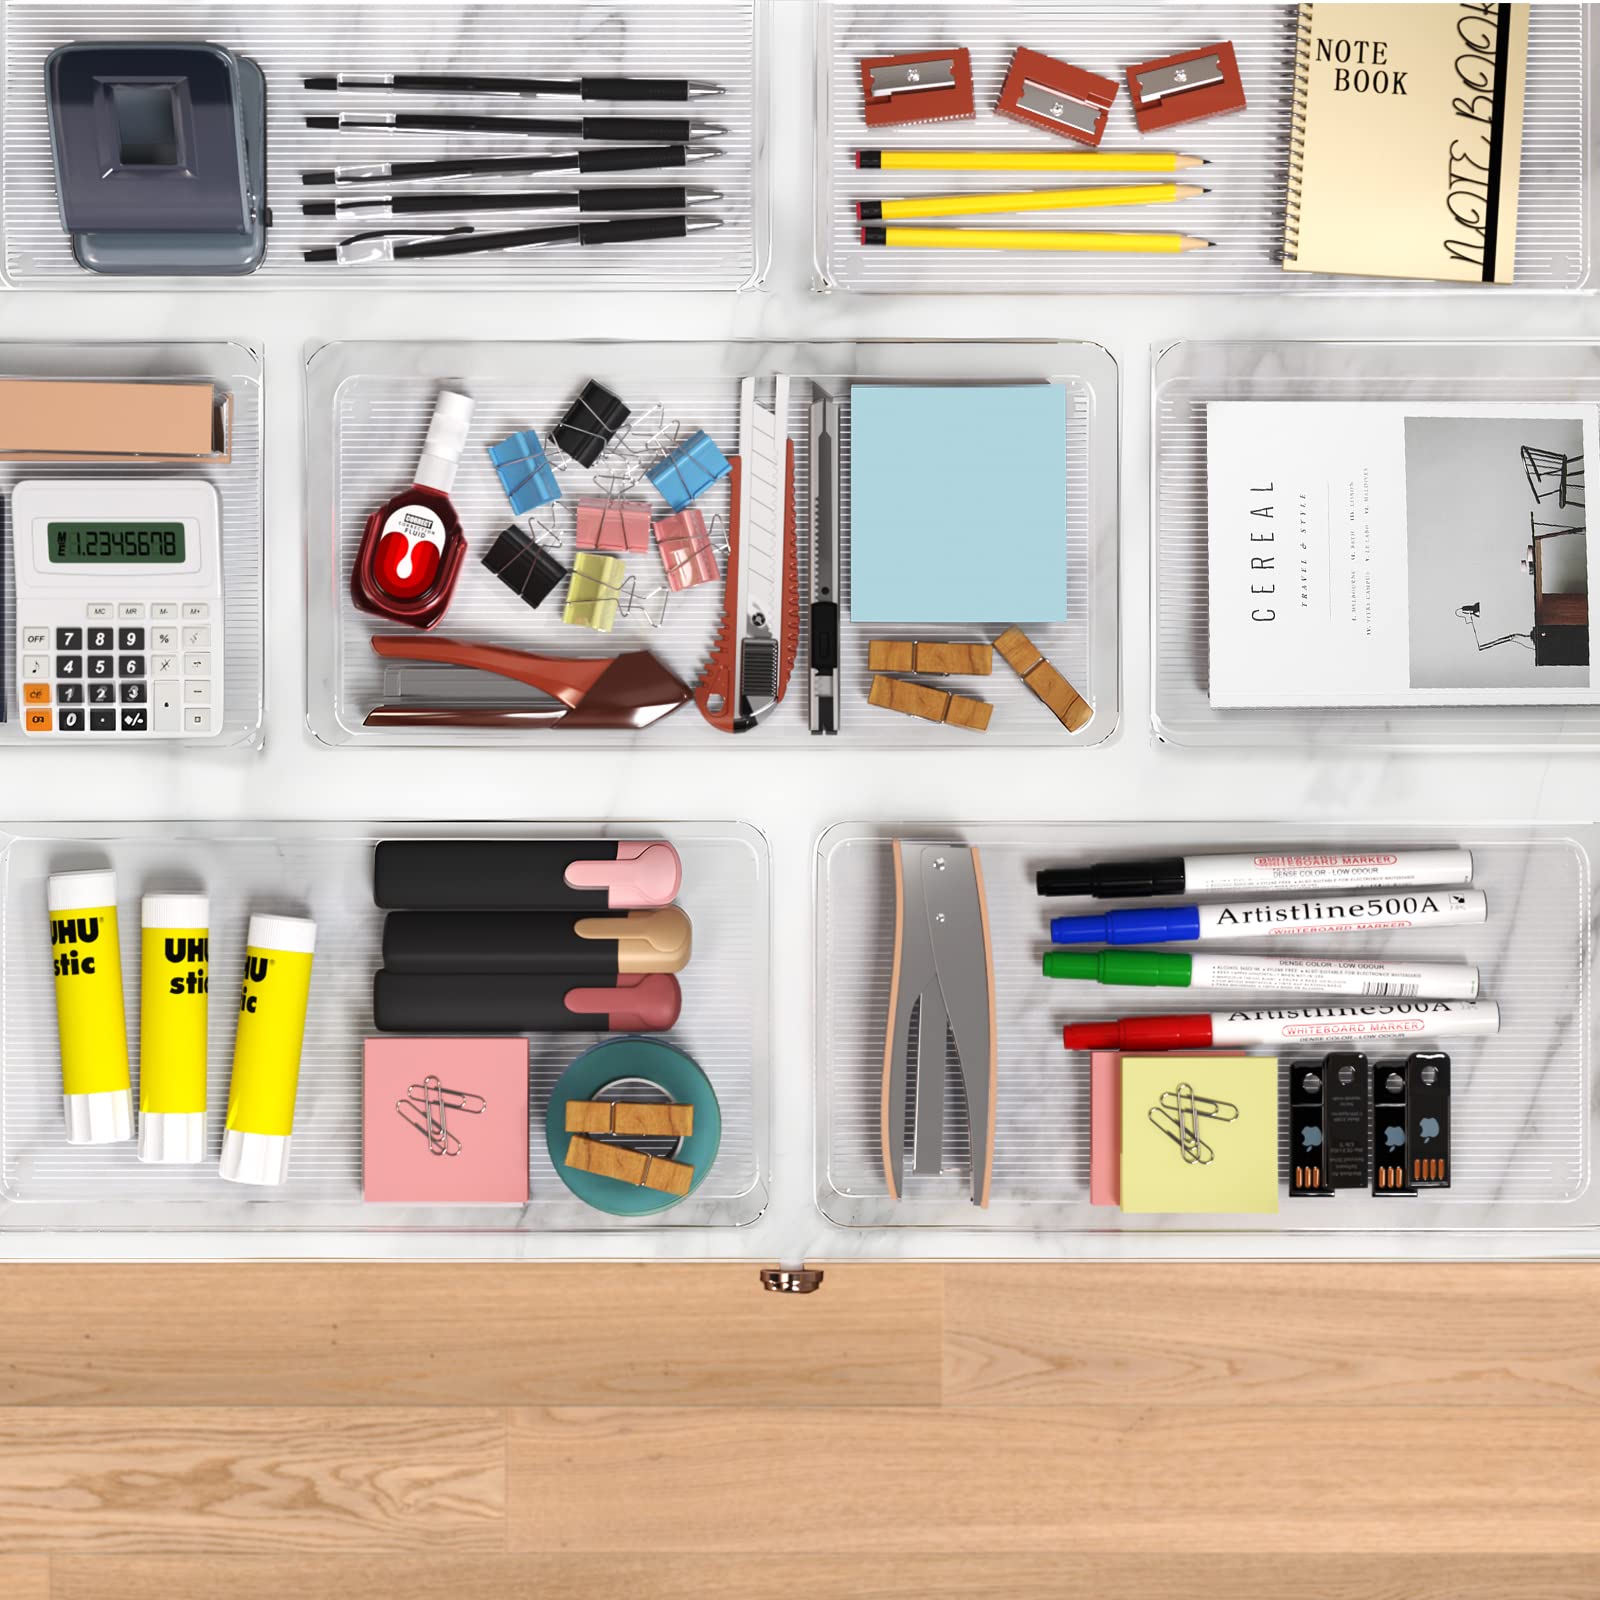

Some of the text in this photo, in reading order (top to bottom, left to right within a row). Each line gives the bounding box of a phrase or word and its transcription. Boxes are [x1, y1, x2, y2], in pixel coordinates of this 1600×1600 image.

[1316, 38, 1388, 65] NOTE
[1334, 68, 1408, 95] BOOK
[404, 527, 426, 539] FLUID
[76, 531, 176, 556] 1.2345678
[1250, 482, 1275, 622] CEREAL
[27, 635, 45, 643] OFF
[64, 632, 74, 646] 7
[95, 632, 105, 646] 8
[126, 632, 136, 646] 9
[63, 660, 136, 674] 4 5 6
[66, 712, 76, 726] 0
[1342, 855, 1391, 865] MARKER
[1273, 870, 1297, 878] DENSE
[1299, 869, 1326, 877] COLOR
[1332, 868, 1350, 876] LOW
[1352, 867, 1379, 875] ODOUR
[1217, 896, 1440, 925] Artistline500A
[164, 938, 208, 963] UH
[1287, 1021, 1419, 1035] WHITEBOARD MARKER
